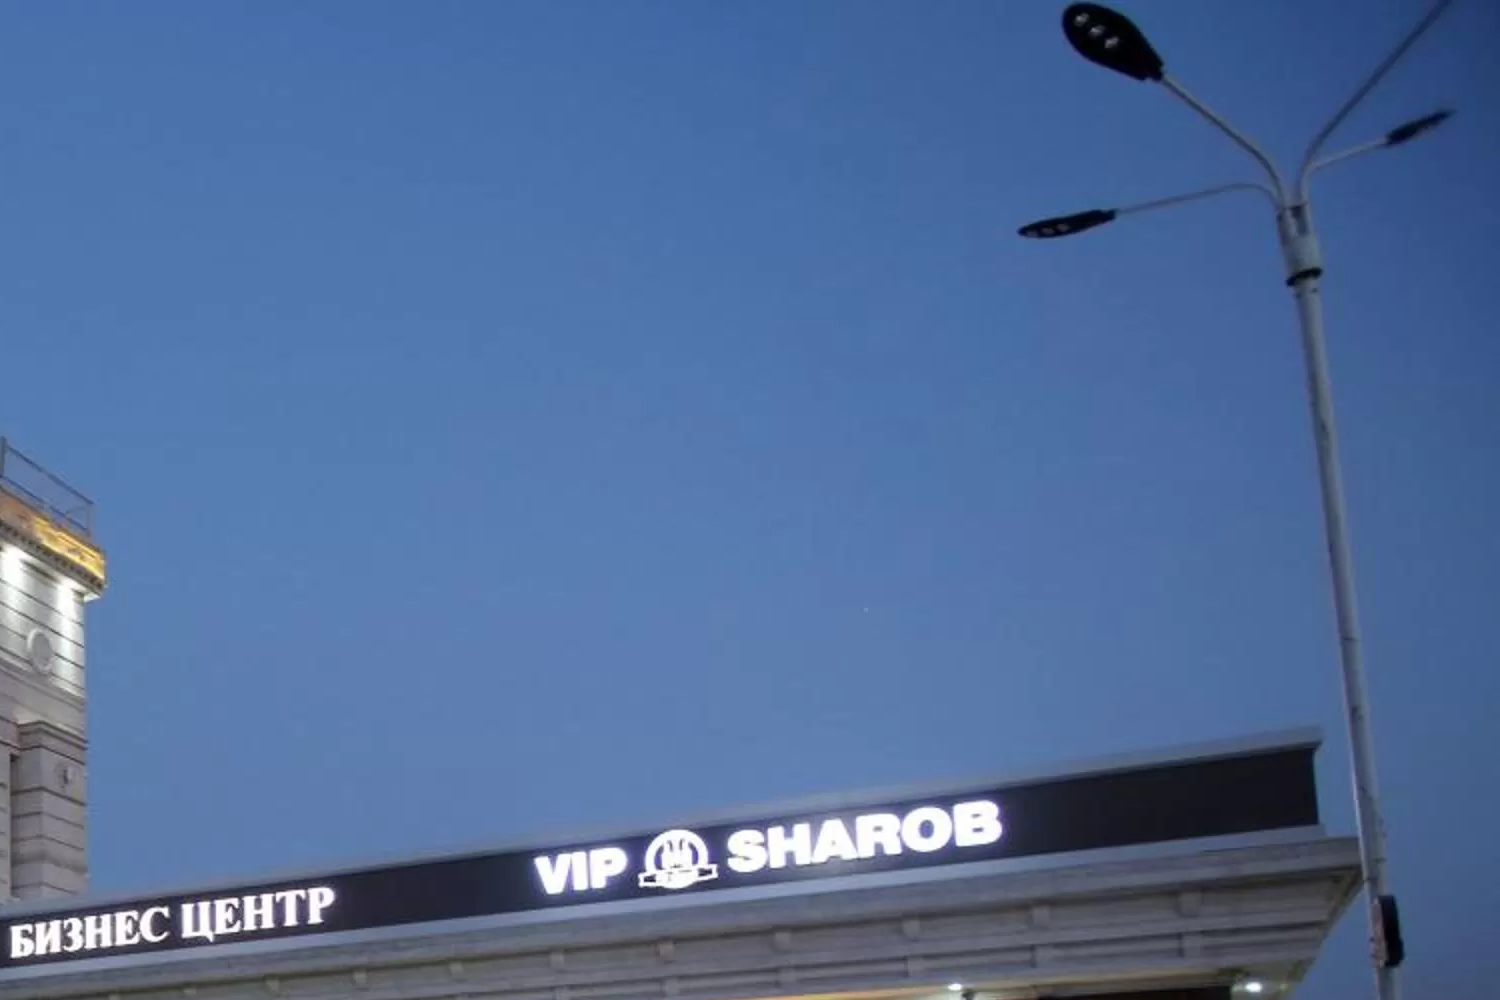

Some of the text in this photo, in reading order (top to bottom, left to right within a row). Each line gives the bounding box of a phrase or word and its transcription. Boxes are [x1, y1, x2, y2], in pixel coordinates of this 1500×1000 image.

[534, 800, 1003, 894] VIP SHAROB
[9, 886, 336, 959] БИЗНЕС ЦЕНТР
